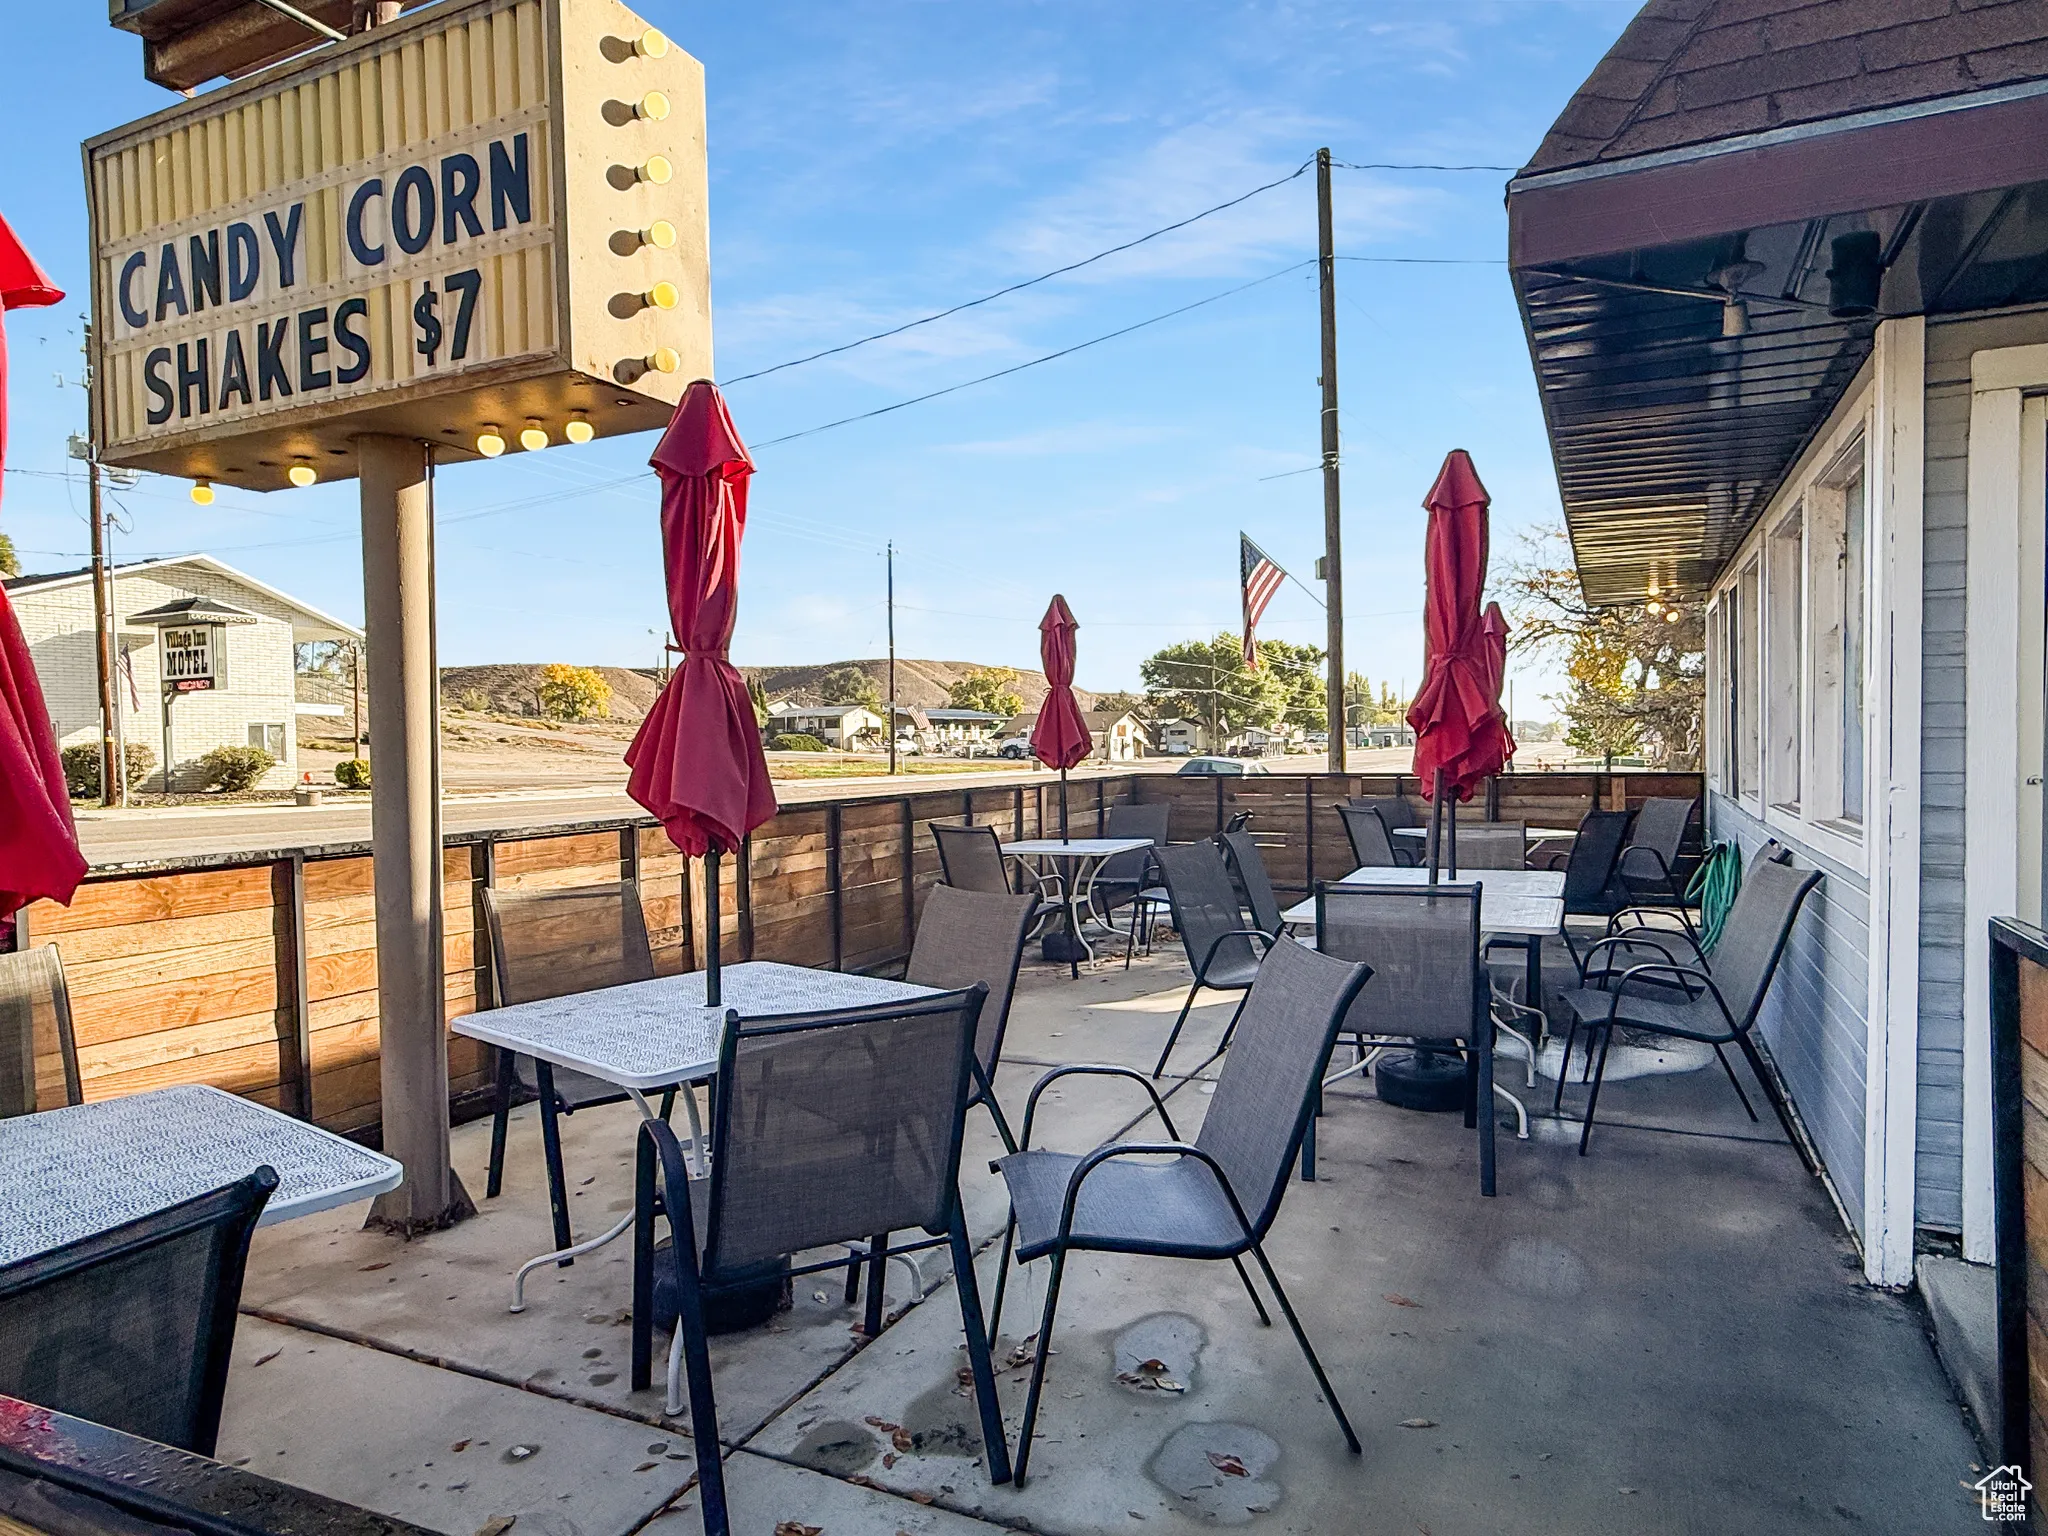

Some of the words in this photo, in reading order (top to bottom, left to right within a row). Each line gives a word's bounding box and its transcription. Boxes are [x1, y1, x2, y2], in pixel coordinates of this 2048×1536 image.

[118, 202, 303, 329] CANDY
[346, 132, 532, 267] CORN
[144, 298, 371, 425] SHAKES
[413, 268, 482, 366] $7
[165, 630, 192, 651] Village
[193, 629, 207, 646] Inn
[166, 649, 208, 676] MOTEL
[176, 680, 210, 690] VACANCY
